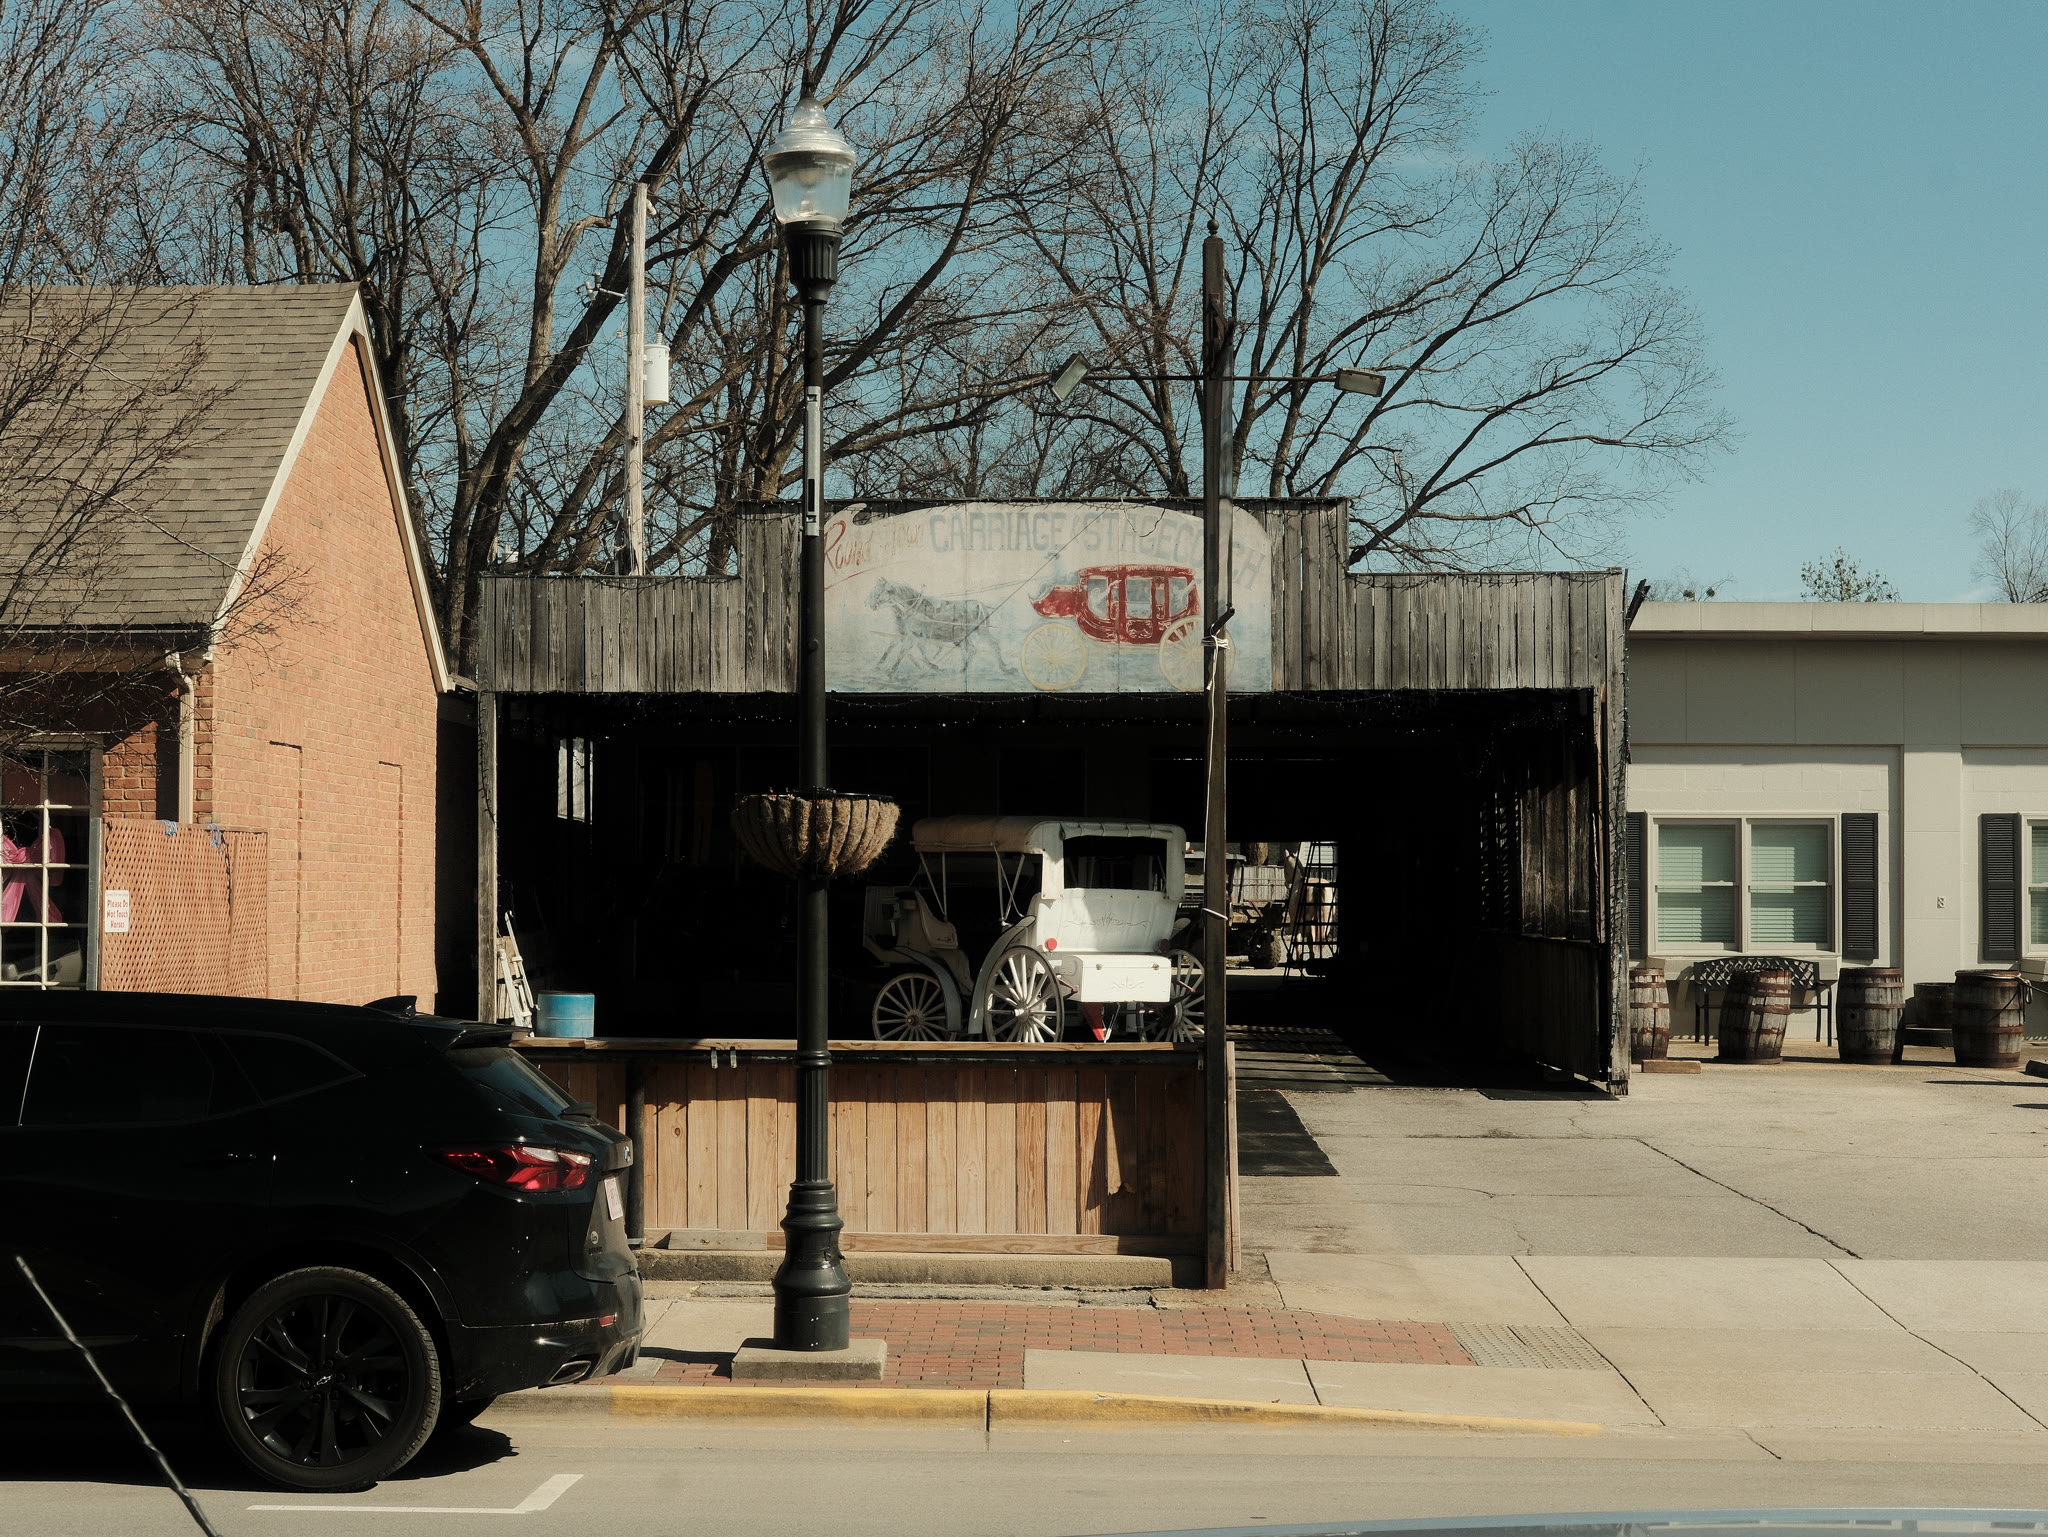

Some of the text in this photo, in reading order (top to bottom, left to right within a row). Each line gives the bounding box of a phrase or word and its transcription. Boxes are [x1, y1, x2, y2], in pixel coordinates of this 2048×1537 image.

[929, 511, 1067, 552] CARRIAGE
[123, 900, 128, 908] Do
[106, 910, 116, 918] Not
[110, 920, 124, 928] Horses
